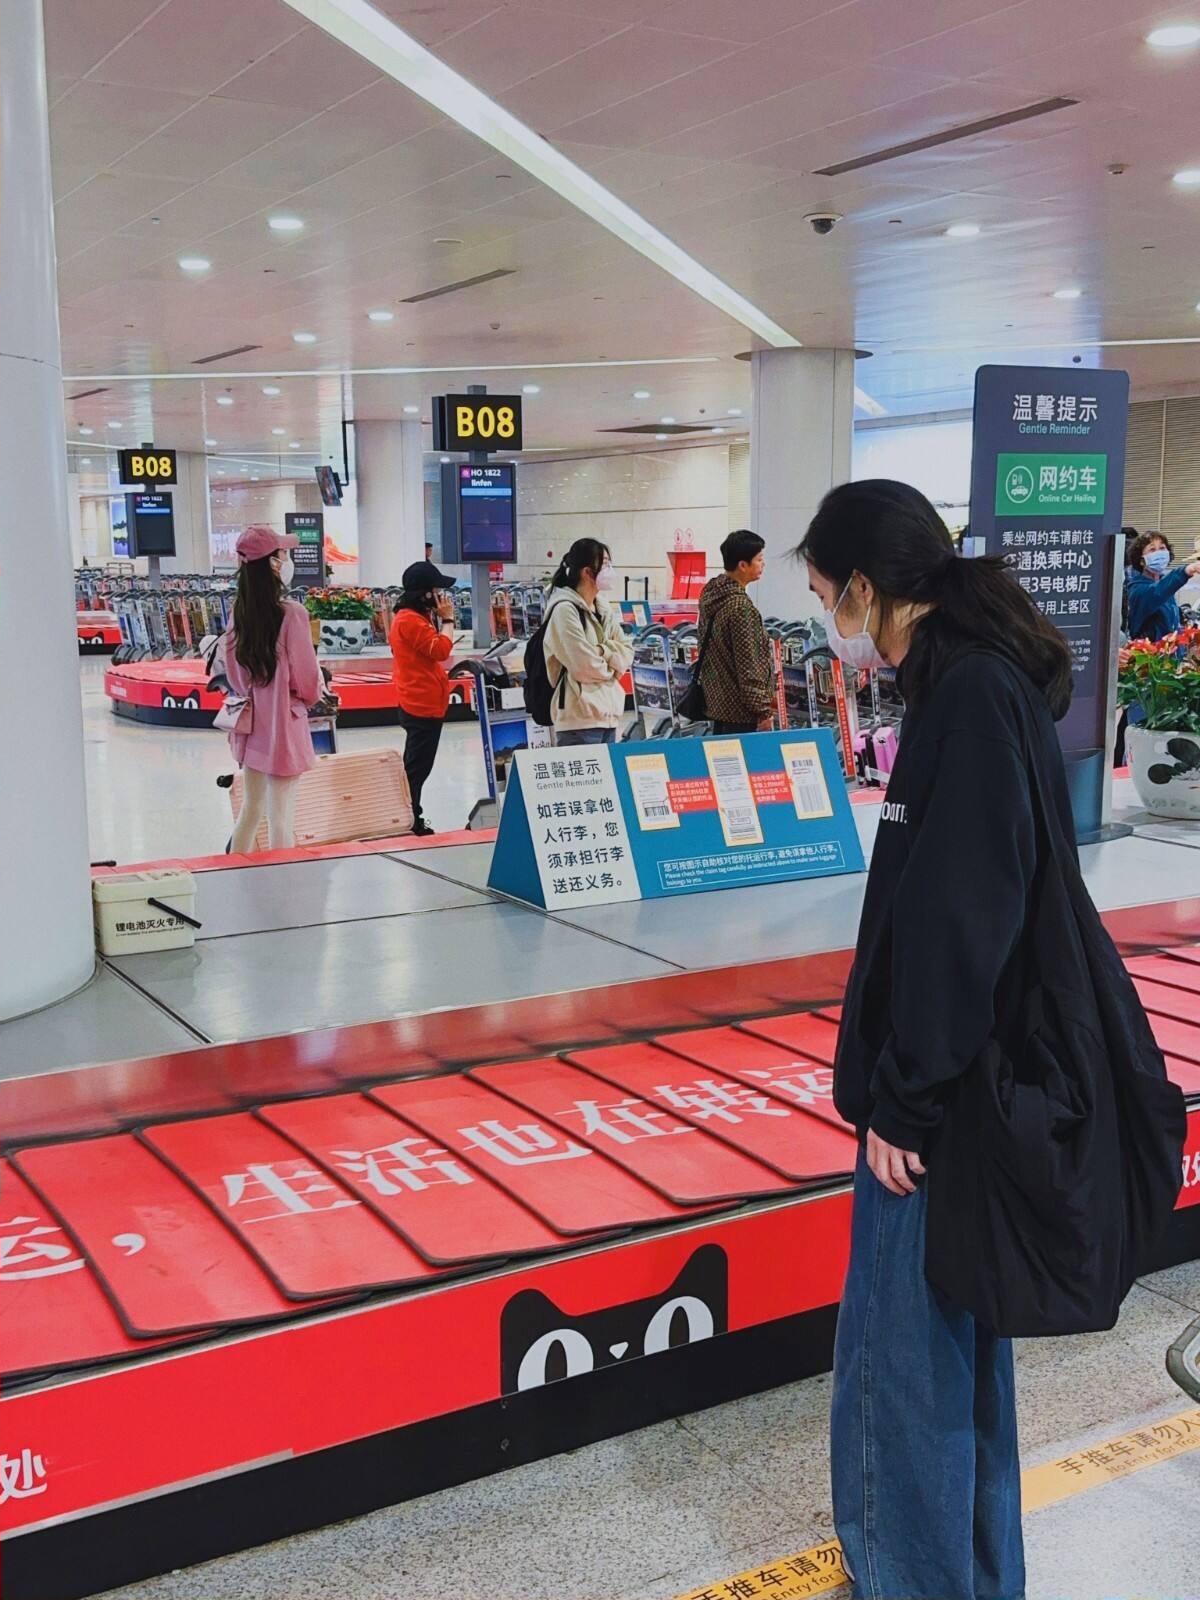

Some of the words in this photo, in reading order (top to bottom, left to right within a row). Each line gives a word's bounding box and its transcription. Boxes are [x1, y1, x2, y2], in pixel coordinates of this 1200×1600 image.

[1012, 394, 1099, 423] 温馨提示
[456, 406, 515, 438] B08
[1018, 423, 1047, 435] Gentle
[1049, 423, 1091, 435] Reminder
[131, 456, 173, 478] B08
[1039, 466, 1098, 492] 网约车
[1038, 494, 1061, 503] Online
[1062, 495, 1074, 503] Car
[1074, 494, 1097, 504] Hailing
[1002, 531, 1094, 546] 乘坐网约车请前往
[533, 758, 602, 781] 温馨提示
[536, 780, 564, 791] Gentle
[565, 777, 604, 789] Reminder
[537, 797, 615, 820] 如若误拿他
[544, 821, 620, 845] 人行李，您
[547, 846, 625, 870] 须承担行李
[552, 871, 623, 895] 送还义务。
[1055, 1411, 1200, 1476] 手推车请勿入
